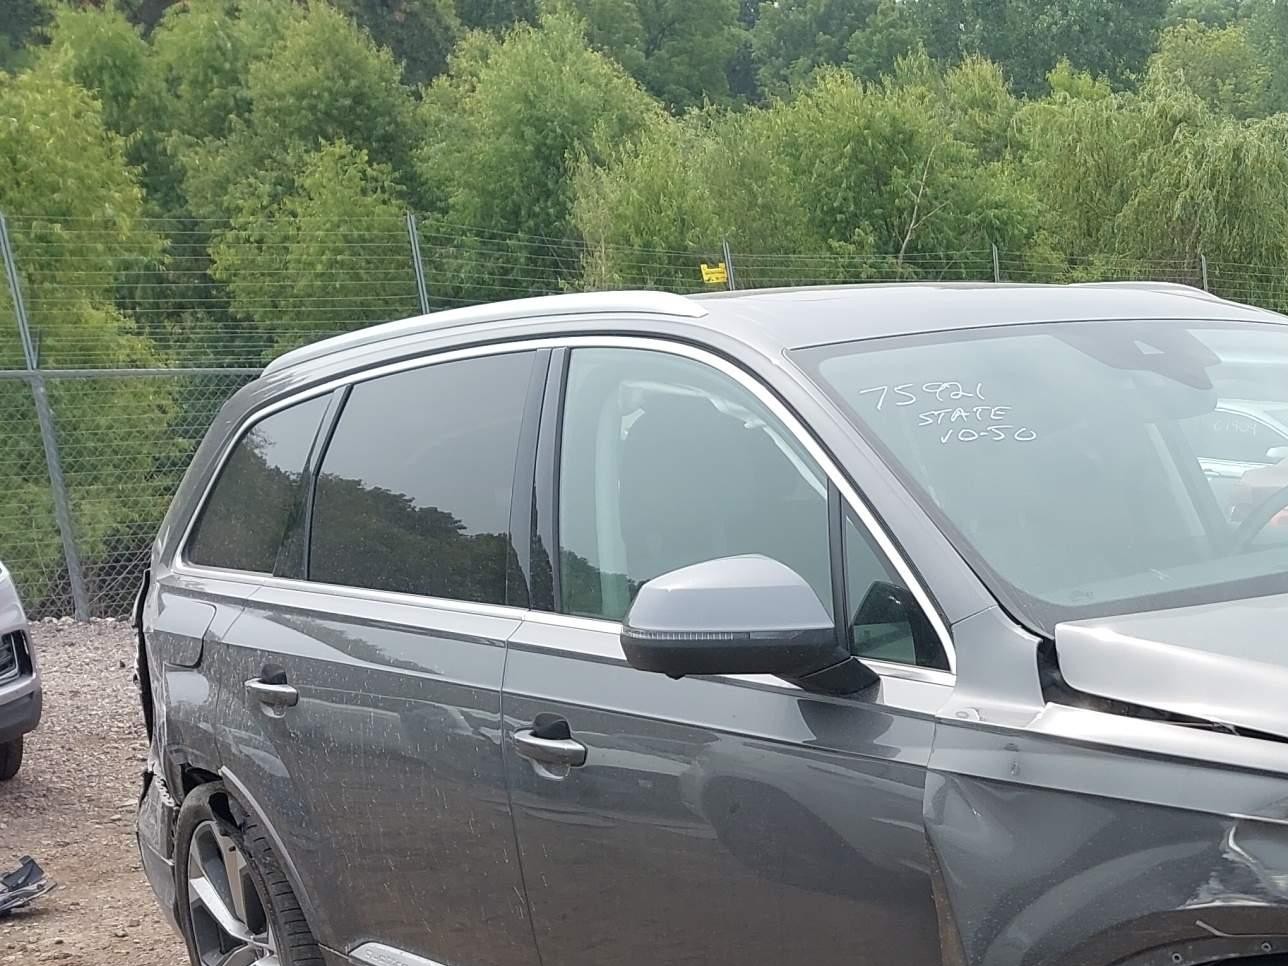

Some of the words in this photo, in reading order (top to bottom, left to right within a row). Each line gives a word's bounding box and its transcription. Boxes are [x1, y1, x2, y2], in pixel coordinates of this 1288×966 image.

[859, 381, 985, 410] 75921
[917, 406, 1013, 426] STATE
[939, 425, 1037, 444] 10-50
